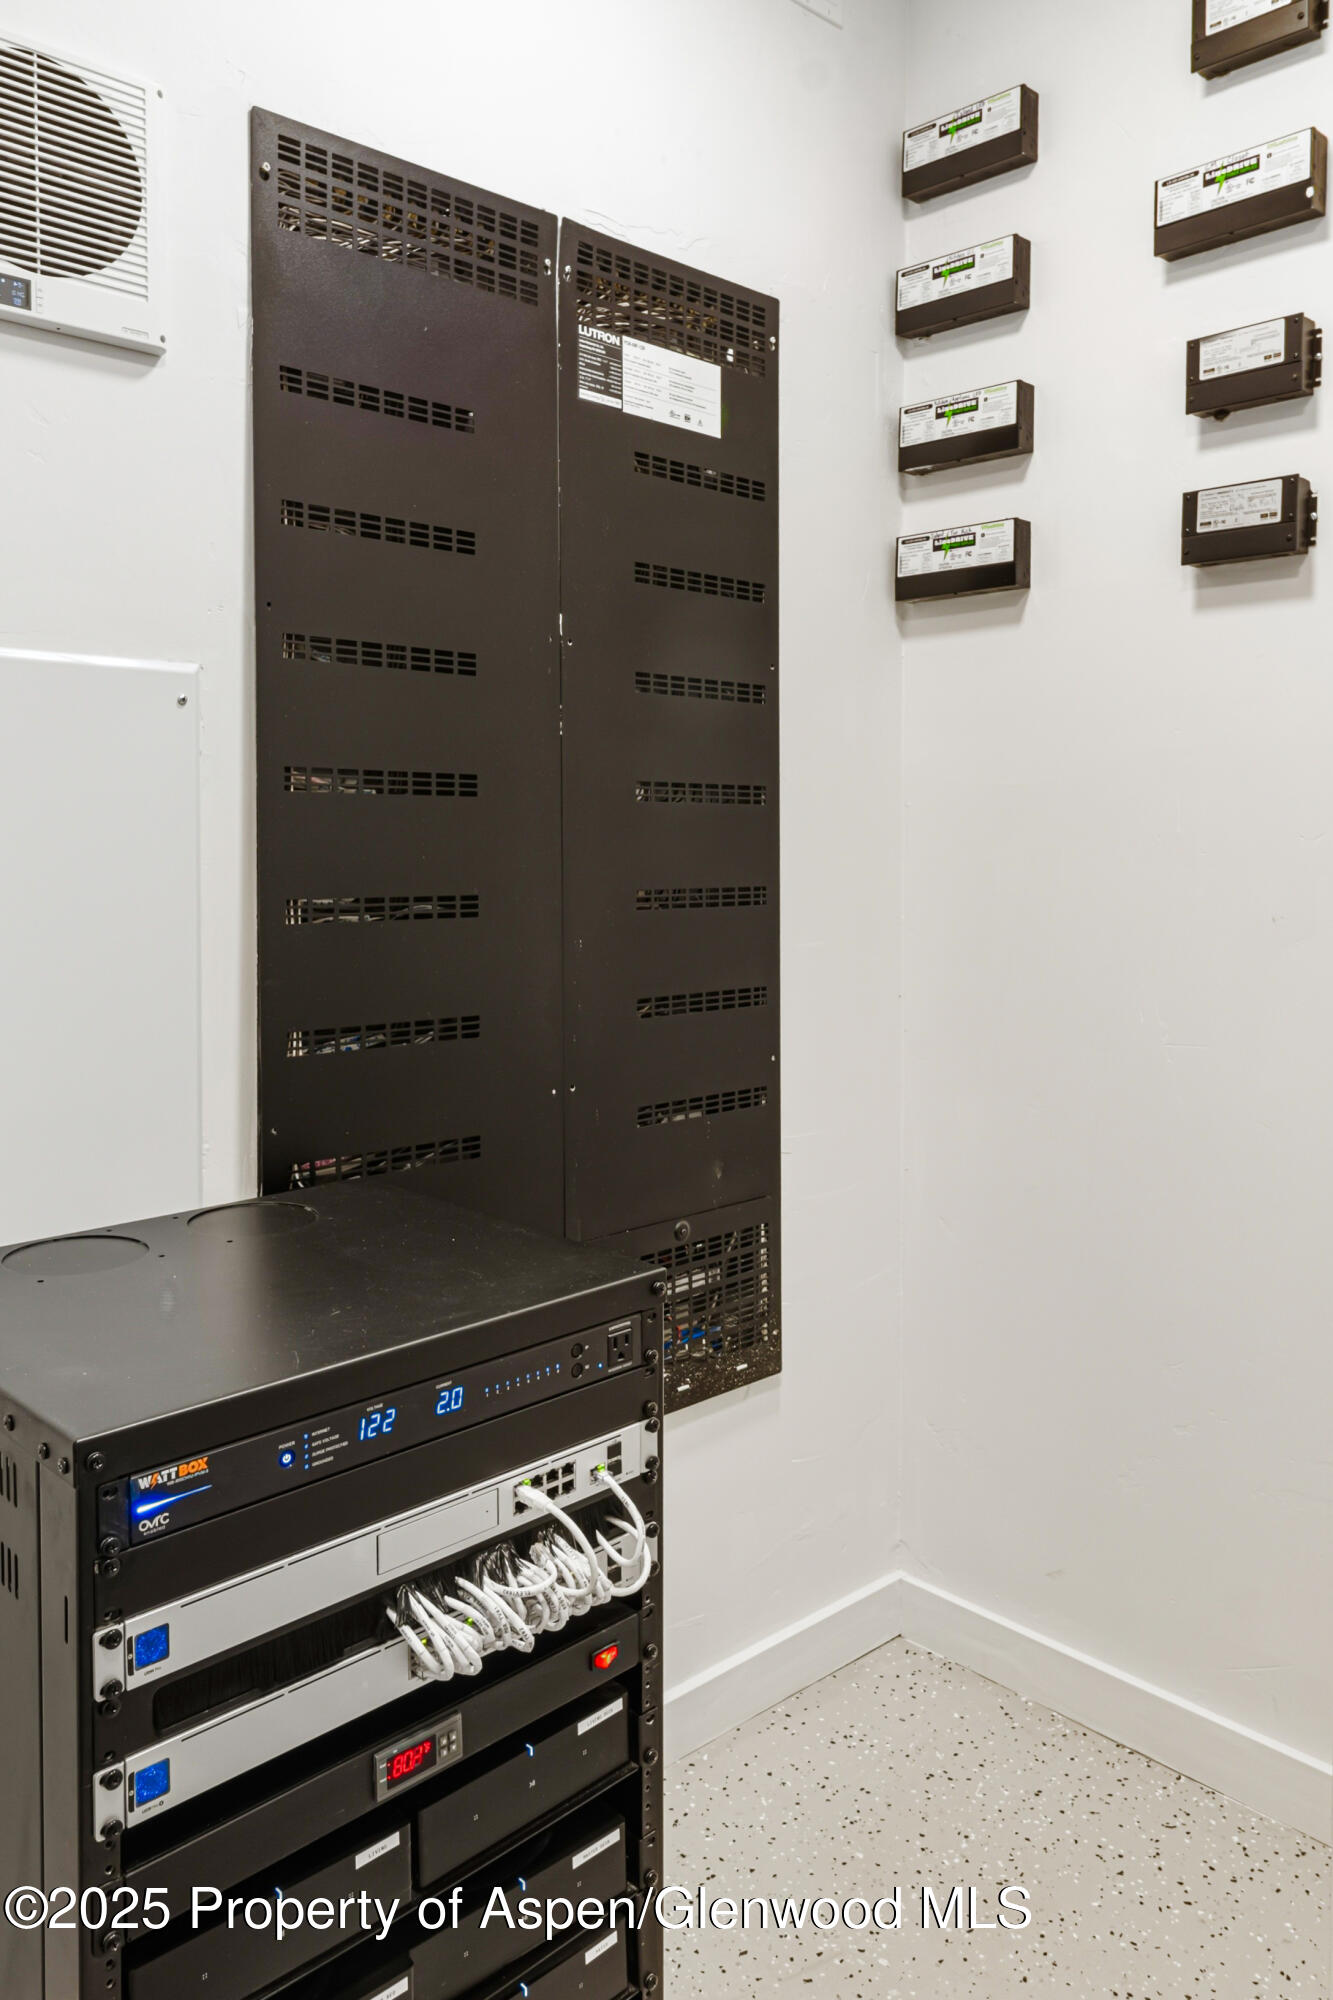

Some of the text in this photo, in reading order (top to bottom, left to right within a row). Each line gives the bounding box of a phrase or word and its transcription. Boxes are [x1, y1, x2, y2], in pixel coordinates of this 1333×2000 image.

[578, 324, 621, 346] LUTRON
[436, 1386, 463, 1415] 2.0
[359, 1408, 396, 1441] 122
